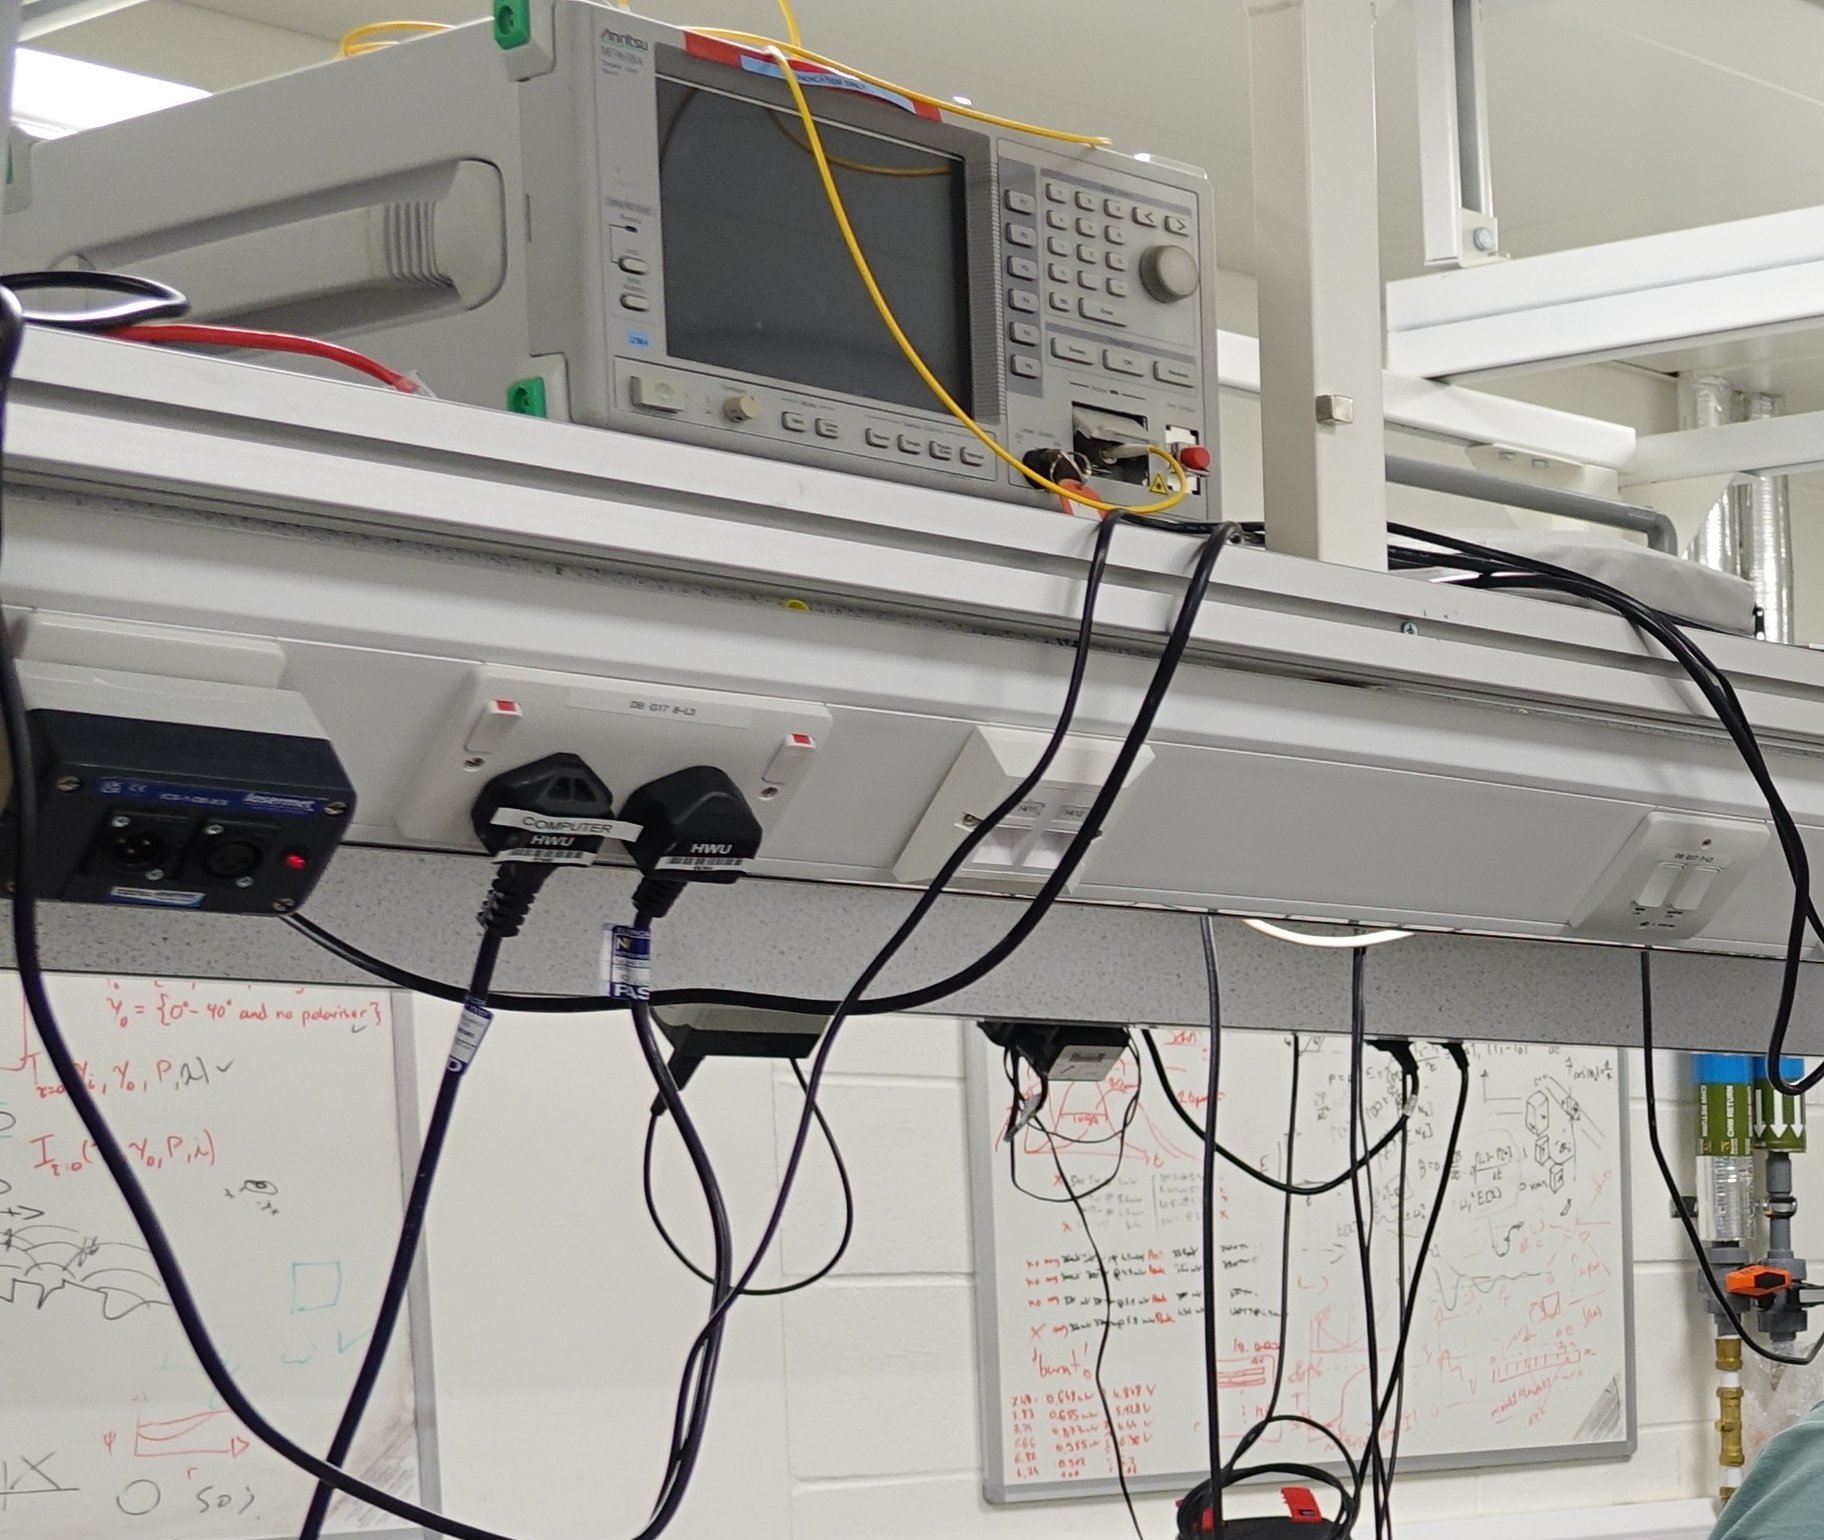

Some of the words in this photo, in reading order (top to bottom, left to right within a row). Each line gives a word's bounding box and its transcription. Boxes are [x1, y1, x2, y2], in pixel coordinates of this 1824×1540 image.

[601, 27, 649, 51] Anritsu
[521, 816, 614, 834] COMPUTER
[530, 835, 575, 847] HWU
[690, 843, 732, 854] HWU
[238, 1003, 268, 1020] and
[275, 1008, 293, 1020] no
[1726, 1085, 1735, 1118] RETURN
